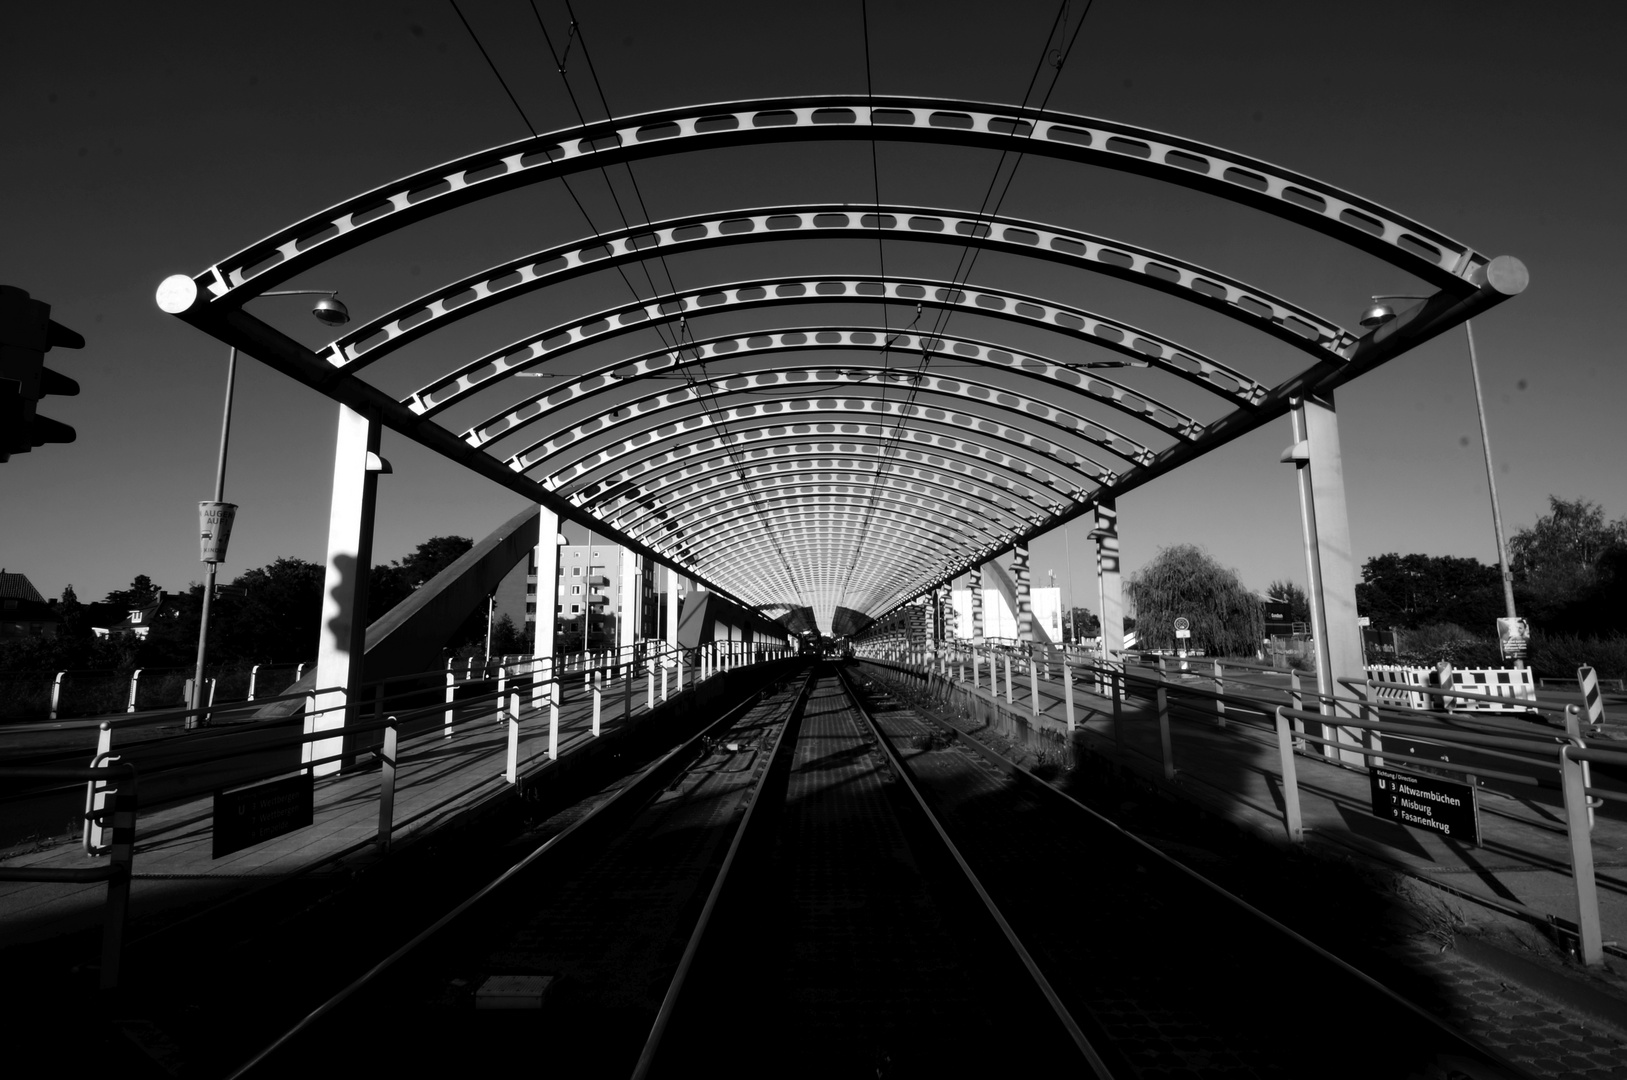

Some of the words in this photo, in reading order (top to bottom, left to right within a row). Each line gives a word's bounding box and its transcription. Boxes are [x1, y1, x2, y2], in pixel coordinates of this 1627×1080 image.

[204, 510, 233, 519] AUGEN
[1378, 778, 1386, 789] U
[1391, 782, 1396, 791] 3
[1399, 784, 1461, 807] Altwarmbüchen
[1391, 795, 1397, 804] 7
[1400, 798, 1432, 817] Misburg
[259, 820, 289, 837] Empelde
[1392, 808, 1399, 818] 9
[1401, 810, 1451, 835] Fasanenkrug
